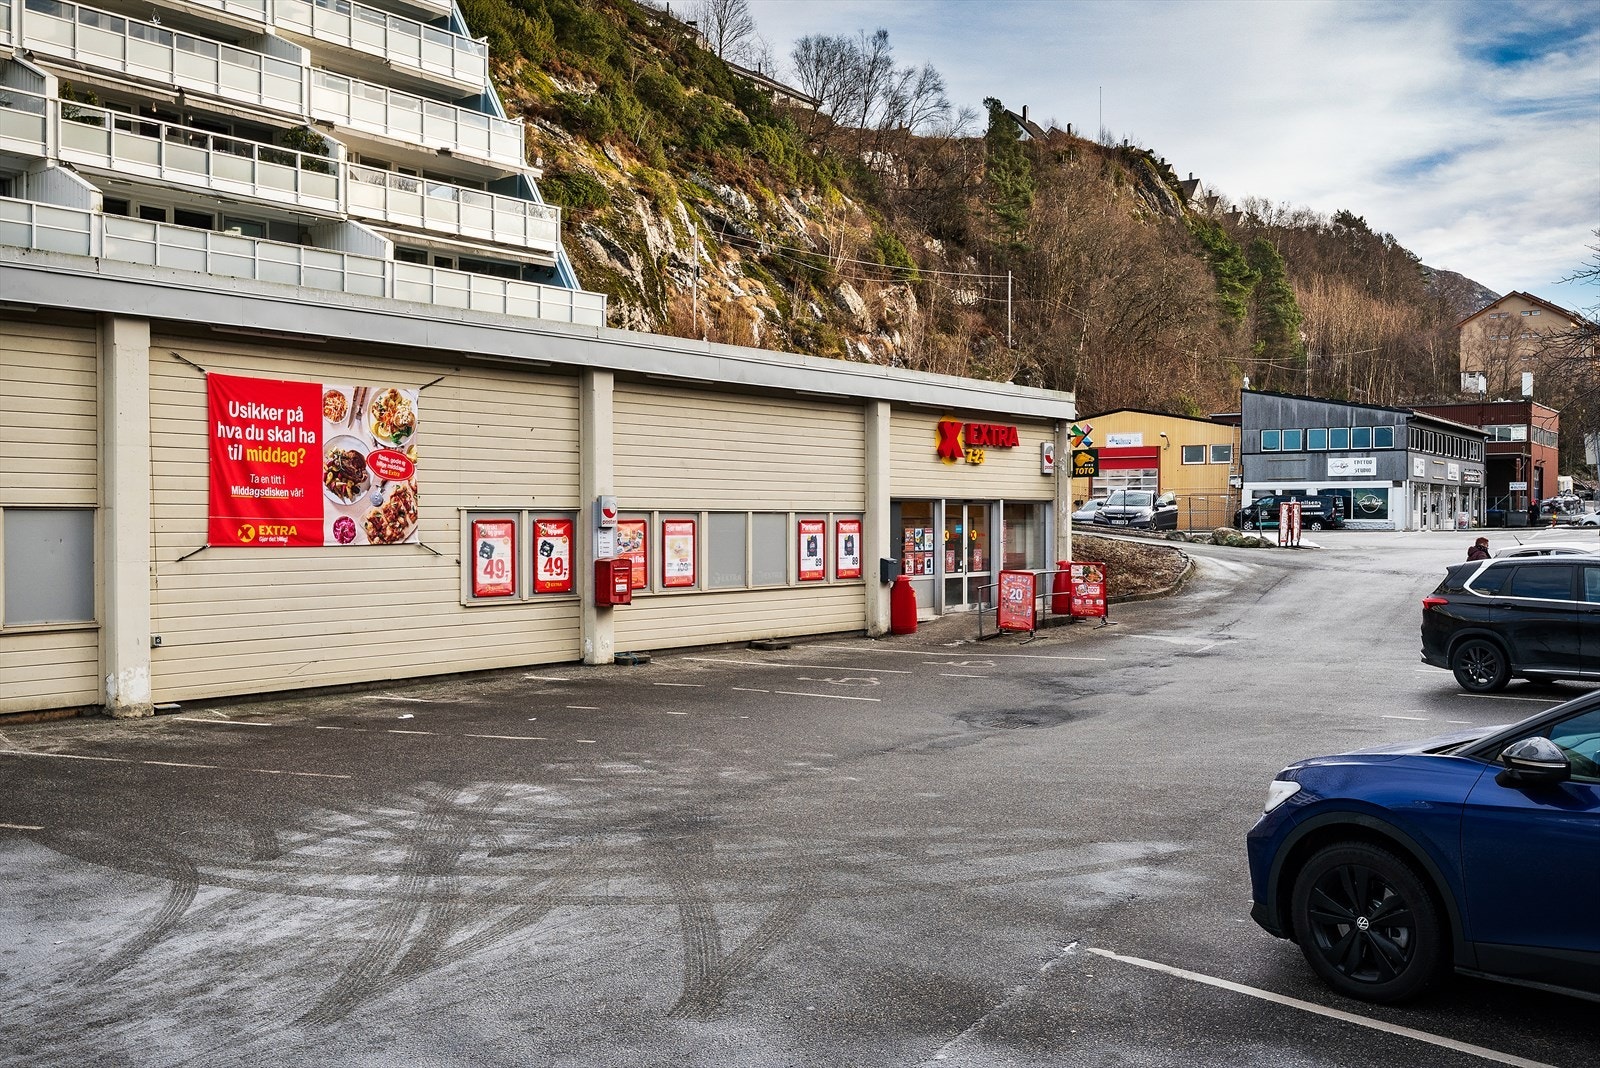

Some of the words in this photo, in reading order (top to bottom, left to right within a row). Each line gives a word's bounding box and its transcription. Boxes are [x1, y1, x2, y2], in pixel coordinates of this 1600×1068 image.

[228, 400, 283, 420] Usikker
[286, 406, 304, 425] på
[218, 421, 242, 440] hva
[245, 424, 264, 441] du
[267, 426, 296, 442] skal
[299, 427, 316, 444] ha
[964, 423, 1020, 448] EXTRA
[228, 444, 242, 460] til
[246, 446, 306, 467] middag?
[250, 474, 259, 483] Ta
[261, 475, 269, 484] en
[271, 475, 281, 484] titt
[283, 476, 286, 484] i
[231, 486, 289, 498] Middagsdisken
[290, 488, 304, 497] vår!
[258, 525, 297, 536] EXTRA
[1010, 588, 1022, 600] 20
